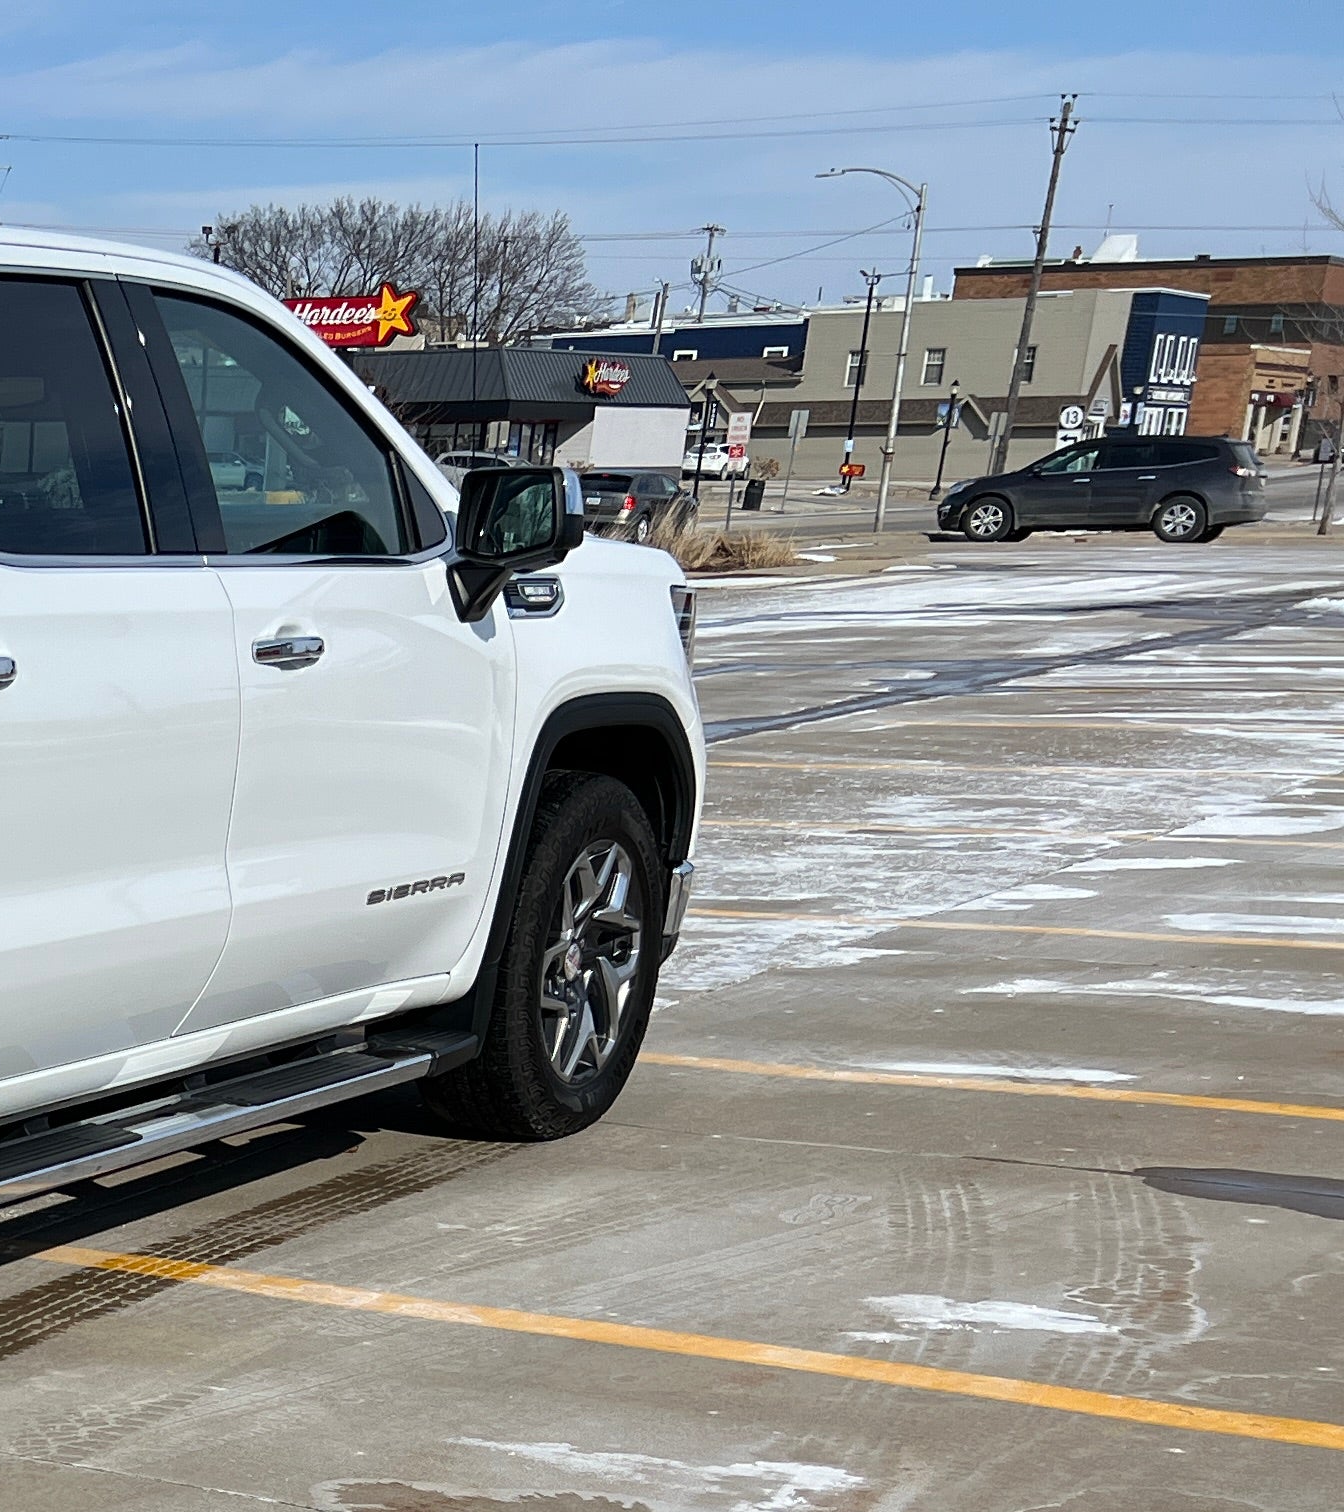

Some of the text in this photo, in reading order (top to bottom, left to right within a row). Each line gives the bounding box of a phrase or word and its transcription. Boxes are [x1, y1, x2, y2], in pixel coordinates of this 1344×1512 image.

[293, 301, 379, 326] Hardee's
[1065, 411, 1079, 425] 13
[366, 872, 465, 905] SIERRA
